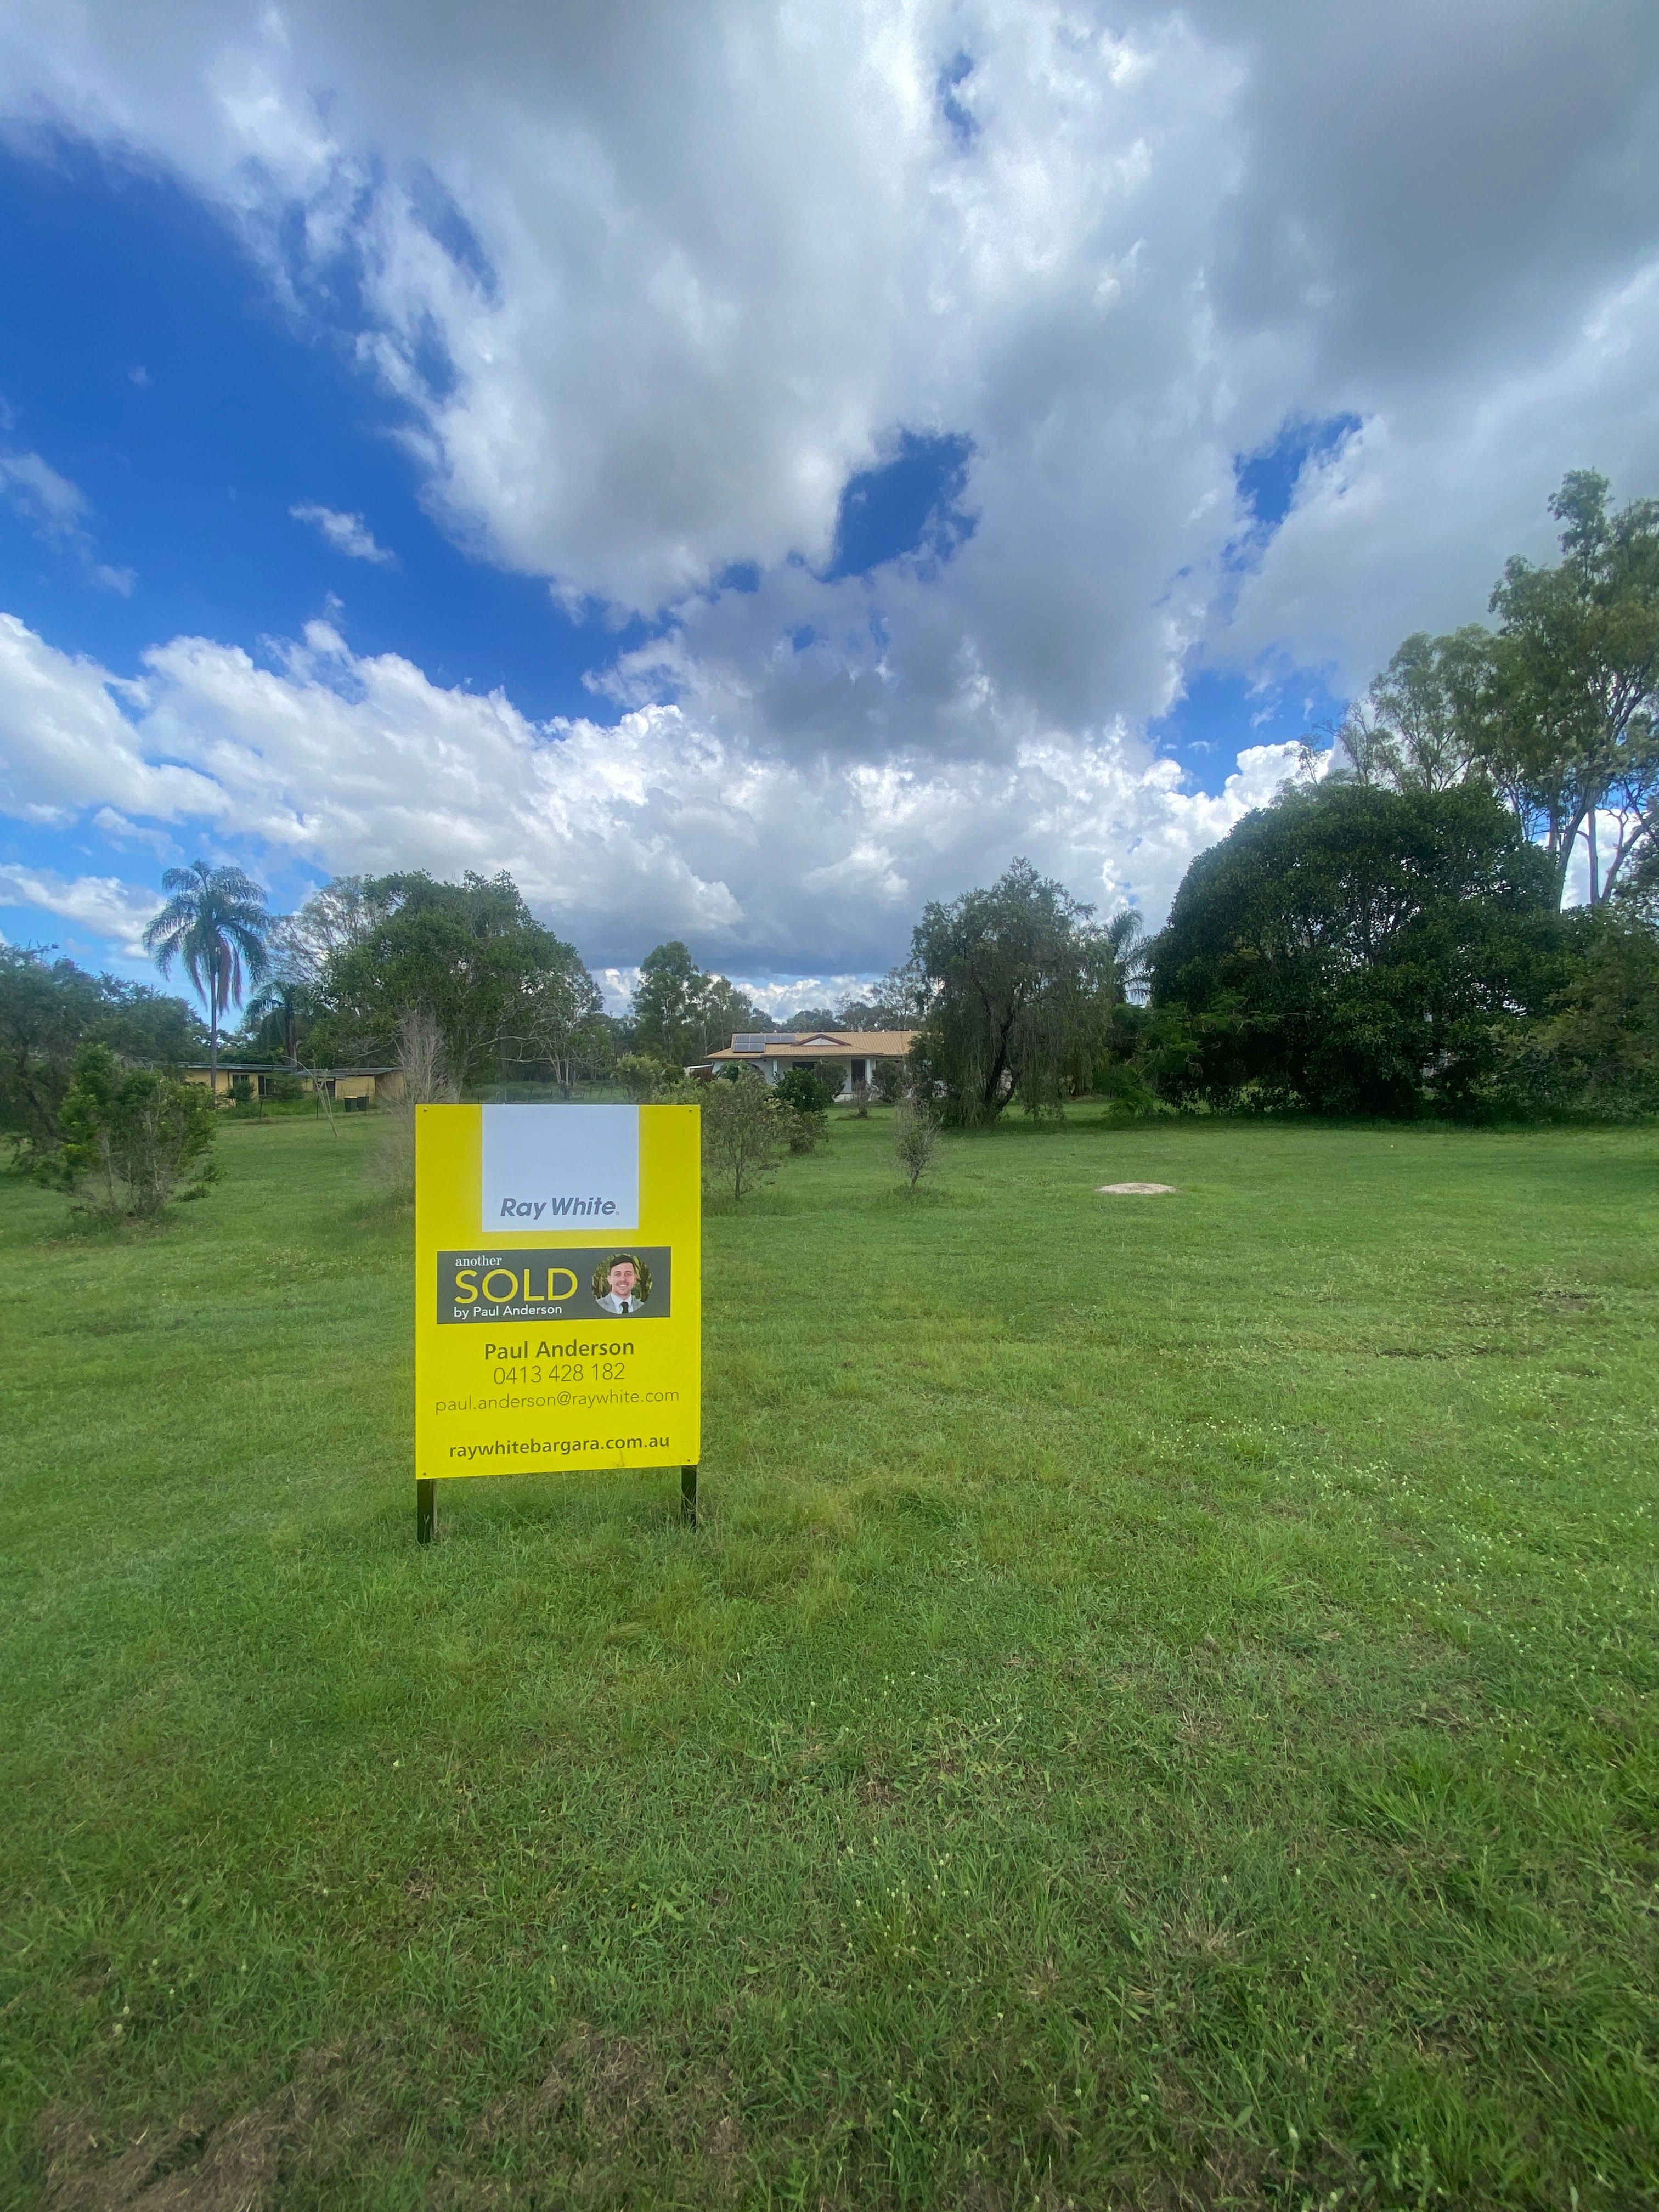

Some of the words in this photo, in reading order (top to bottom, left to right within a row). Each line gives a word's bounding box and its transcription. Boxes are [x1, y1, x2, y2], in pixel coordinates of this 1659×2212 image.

[500, 1197, 548, 1220] Ray
[551, 1197, 616, 1216] White
[455, 1255, 503, 1267] another
[454, 1268, 578, 1304] SOLD
[454, 1306, 470, 1320] by
[473, 1305, 499, 1317] Paul
[503, 1304, 562, 1317] Anderson
[484, 1340, 528, 1360] Paul
[535, 1339, 634, 1358] Anderson
[493, 1365, 542, 1385] 0413
[548, 1363, 584, 1383] 428
[592, 1362, 625, 1381] 182
[435, 1389, 680, 1416] paul.anderson@raywhite.com
[449, 1436, 670, 1460] raywhitebargara.com.au
